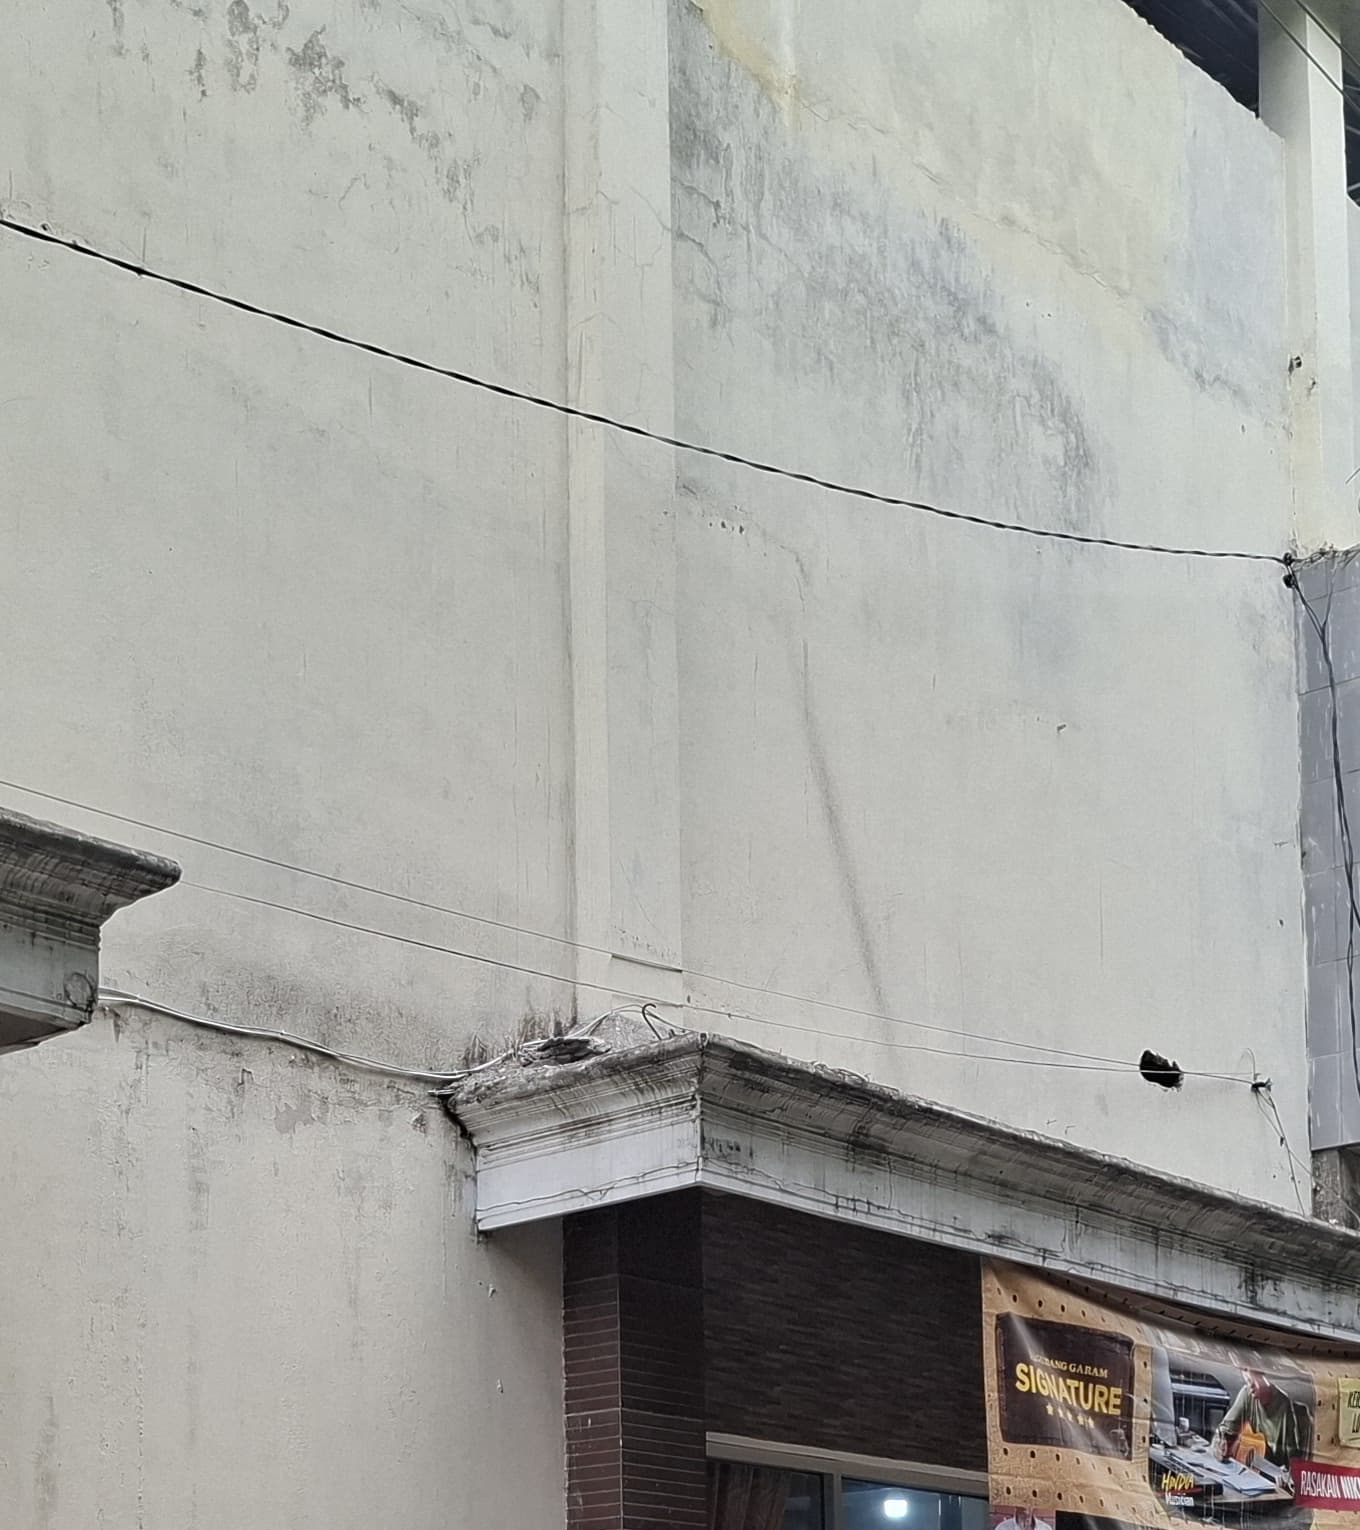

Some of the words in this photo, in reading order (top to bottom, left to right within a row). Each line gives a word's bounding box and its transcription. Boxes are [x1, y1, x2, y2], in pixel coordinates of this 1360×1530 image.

[1069, 1363, 1109, 1379] GARAM
[1015, 1362, 1123, 1416] SIGNATURE
[1300, 1470, 1341, 1498] RASAKAN
